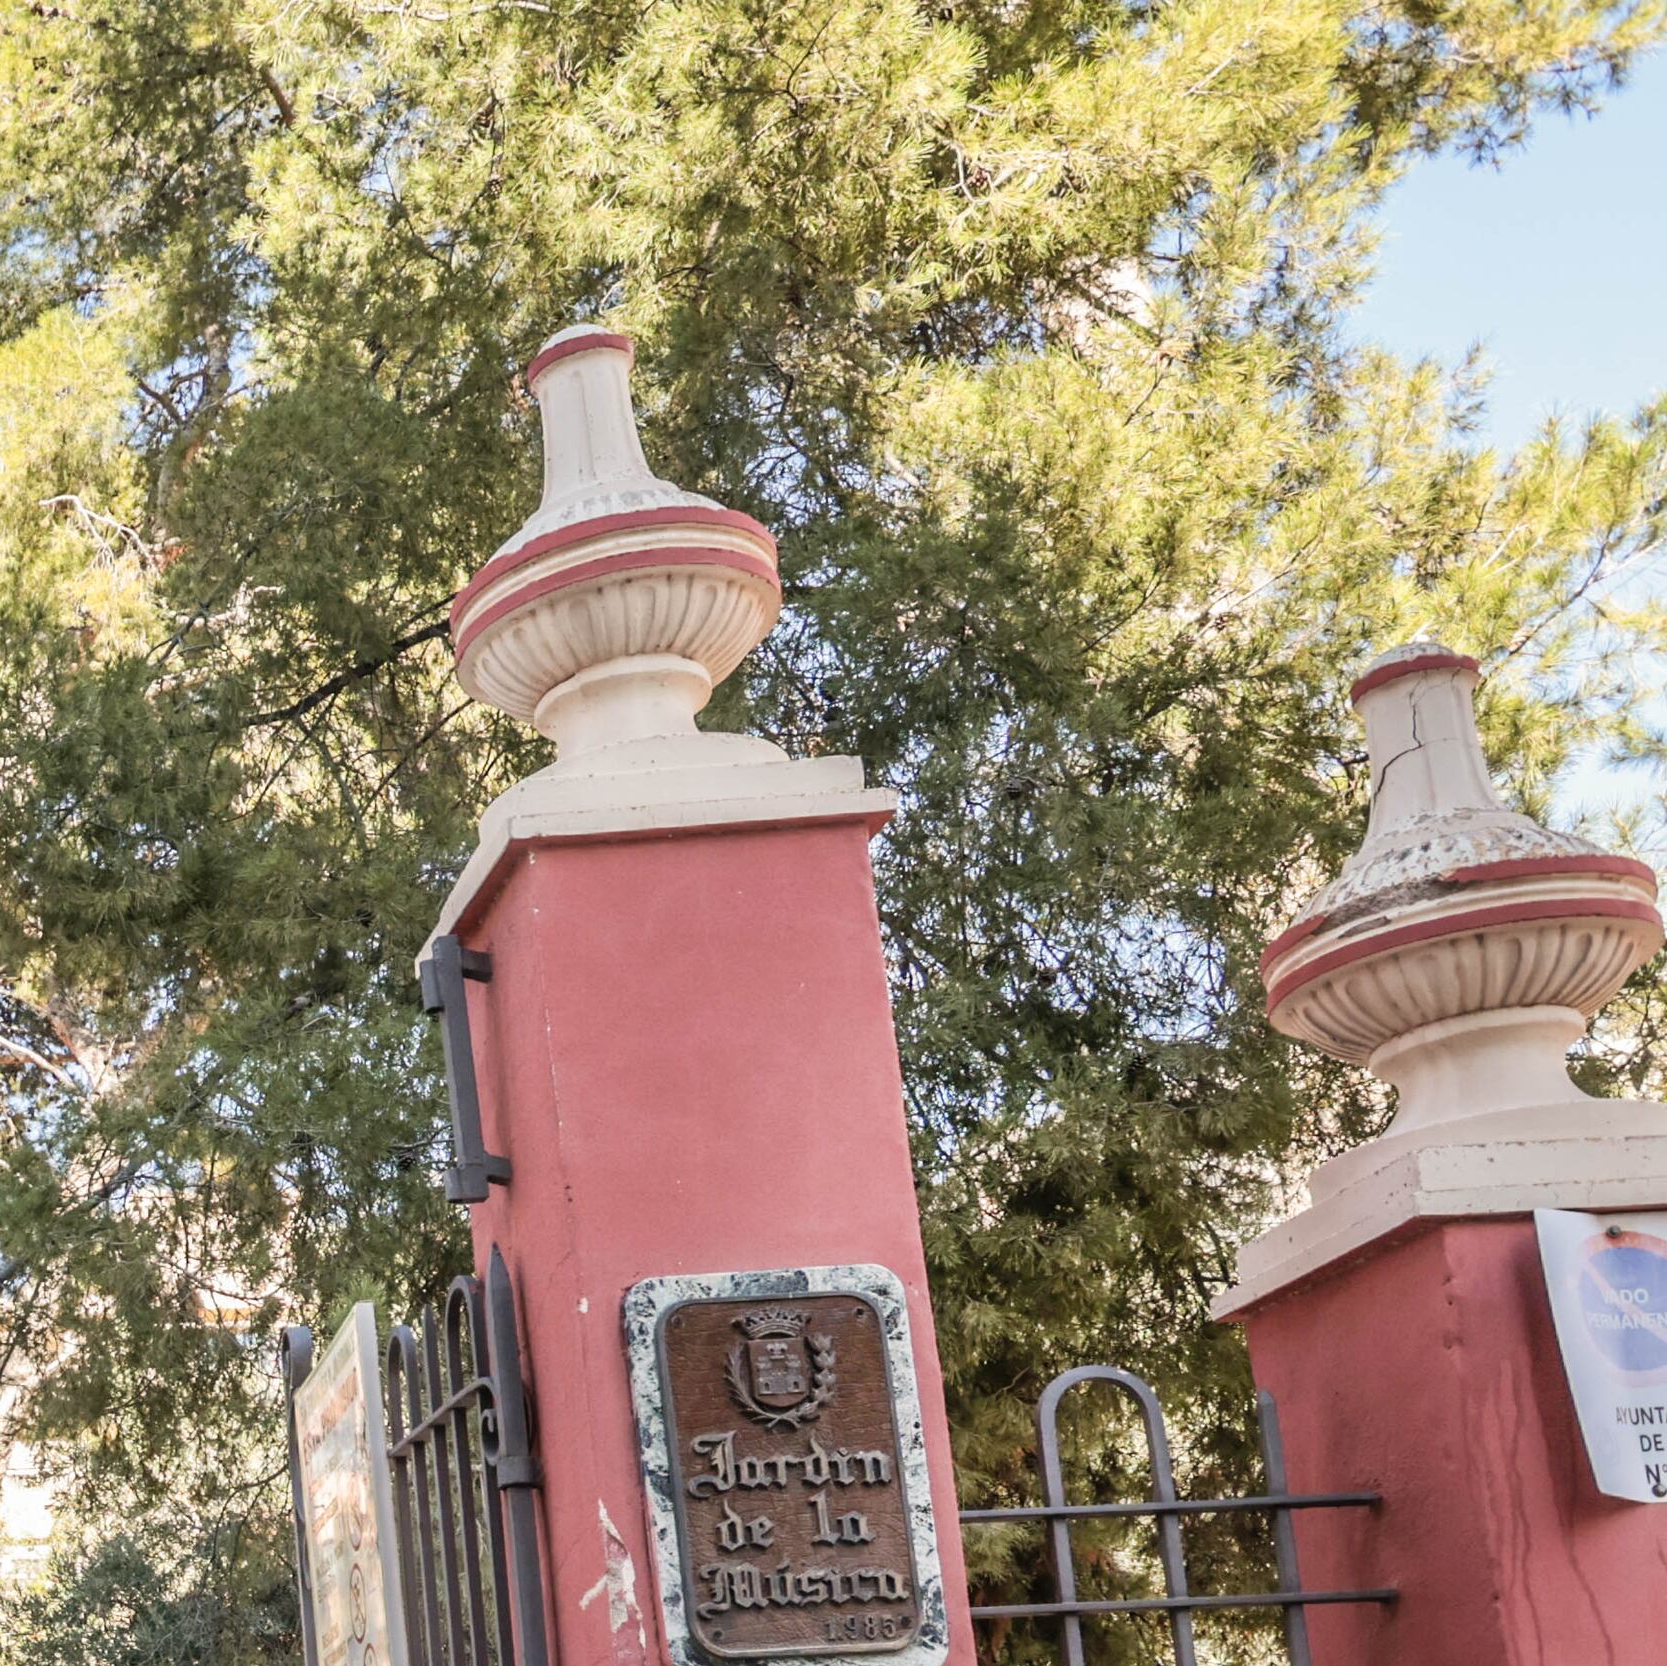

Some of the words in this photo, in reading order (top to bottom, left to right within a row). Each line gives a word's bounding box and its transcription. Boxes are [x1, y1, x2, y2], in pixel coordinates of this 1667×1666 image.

[1616, 1406, 1667, 1425] AYUNT
[1639, 1433, 1665, 1452] DE
[715, 1498, 776, 1551] de
[808, 1490, 877, 1545] la
